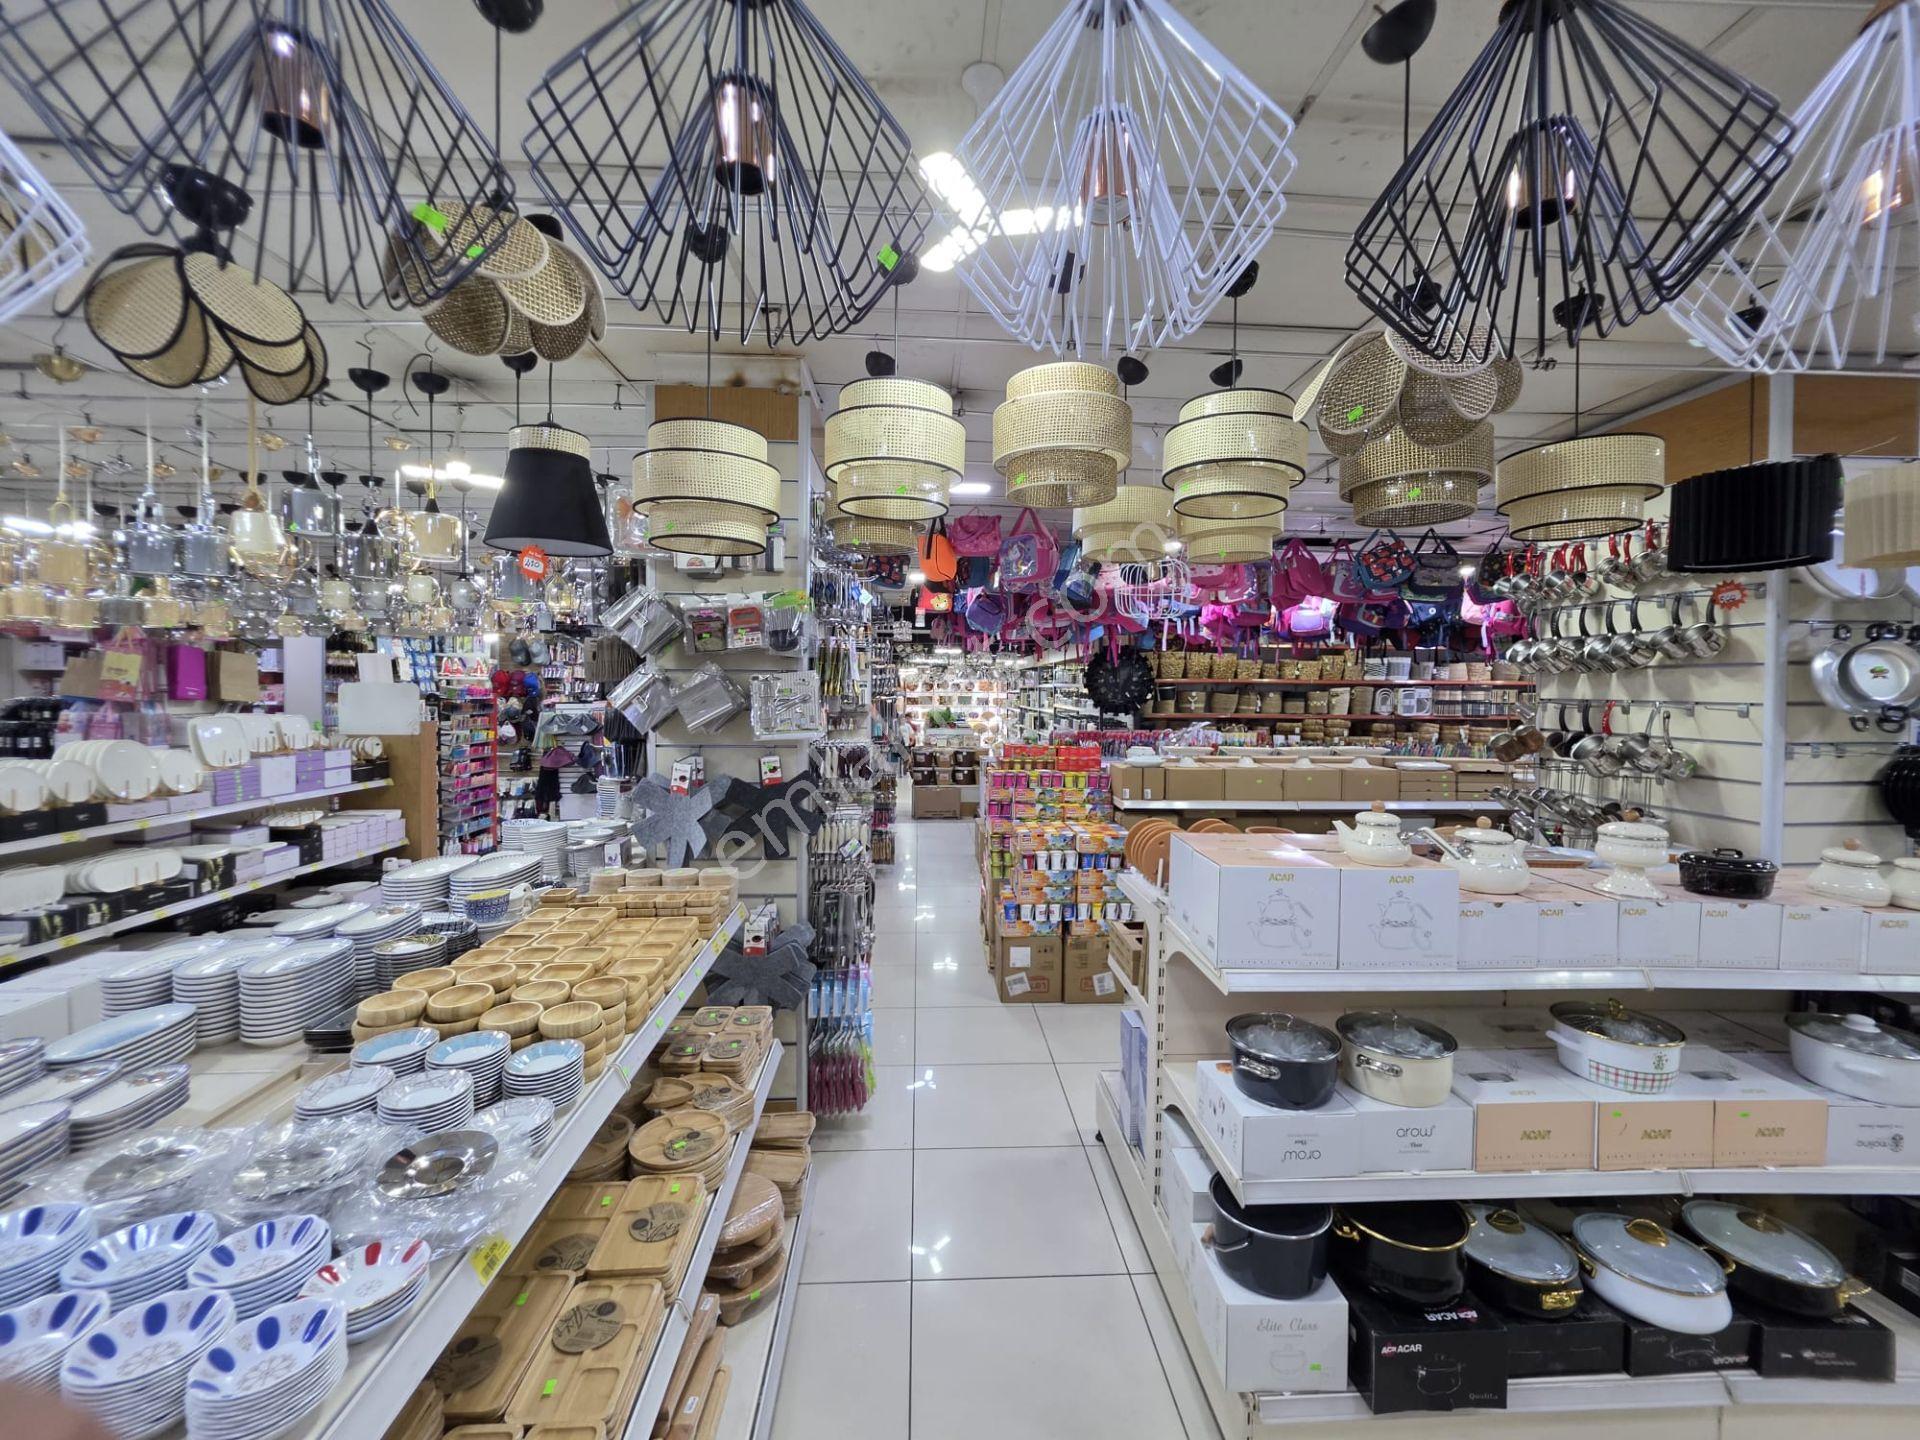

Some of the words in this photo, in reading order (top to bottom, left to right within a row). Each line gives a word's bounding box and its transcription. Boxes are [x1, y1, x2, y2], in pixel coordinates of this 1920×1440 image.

[1268, 873, 1295, 882] ACAR
[1388, 875, 1415, 884] ACAR
[1256, 1317, 1283, 1332] Elite
[1289, 1317, 1319, 1332] Class
[1397, 1343, 1423, 1353] ACAR
